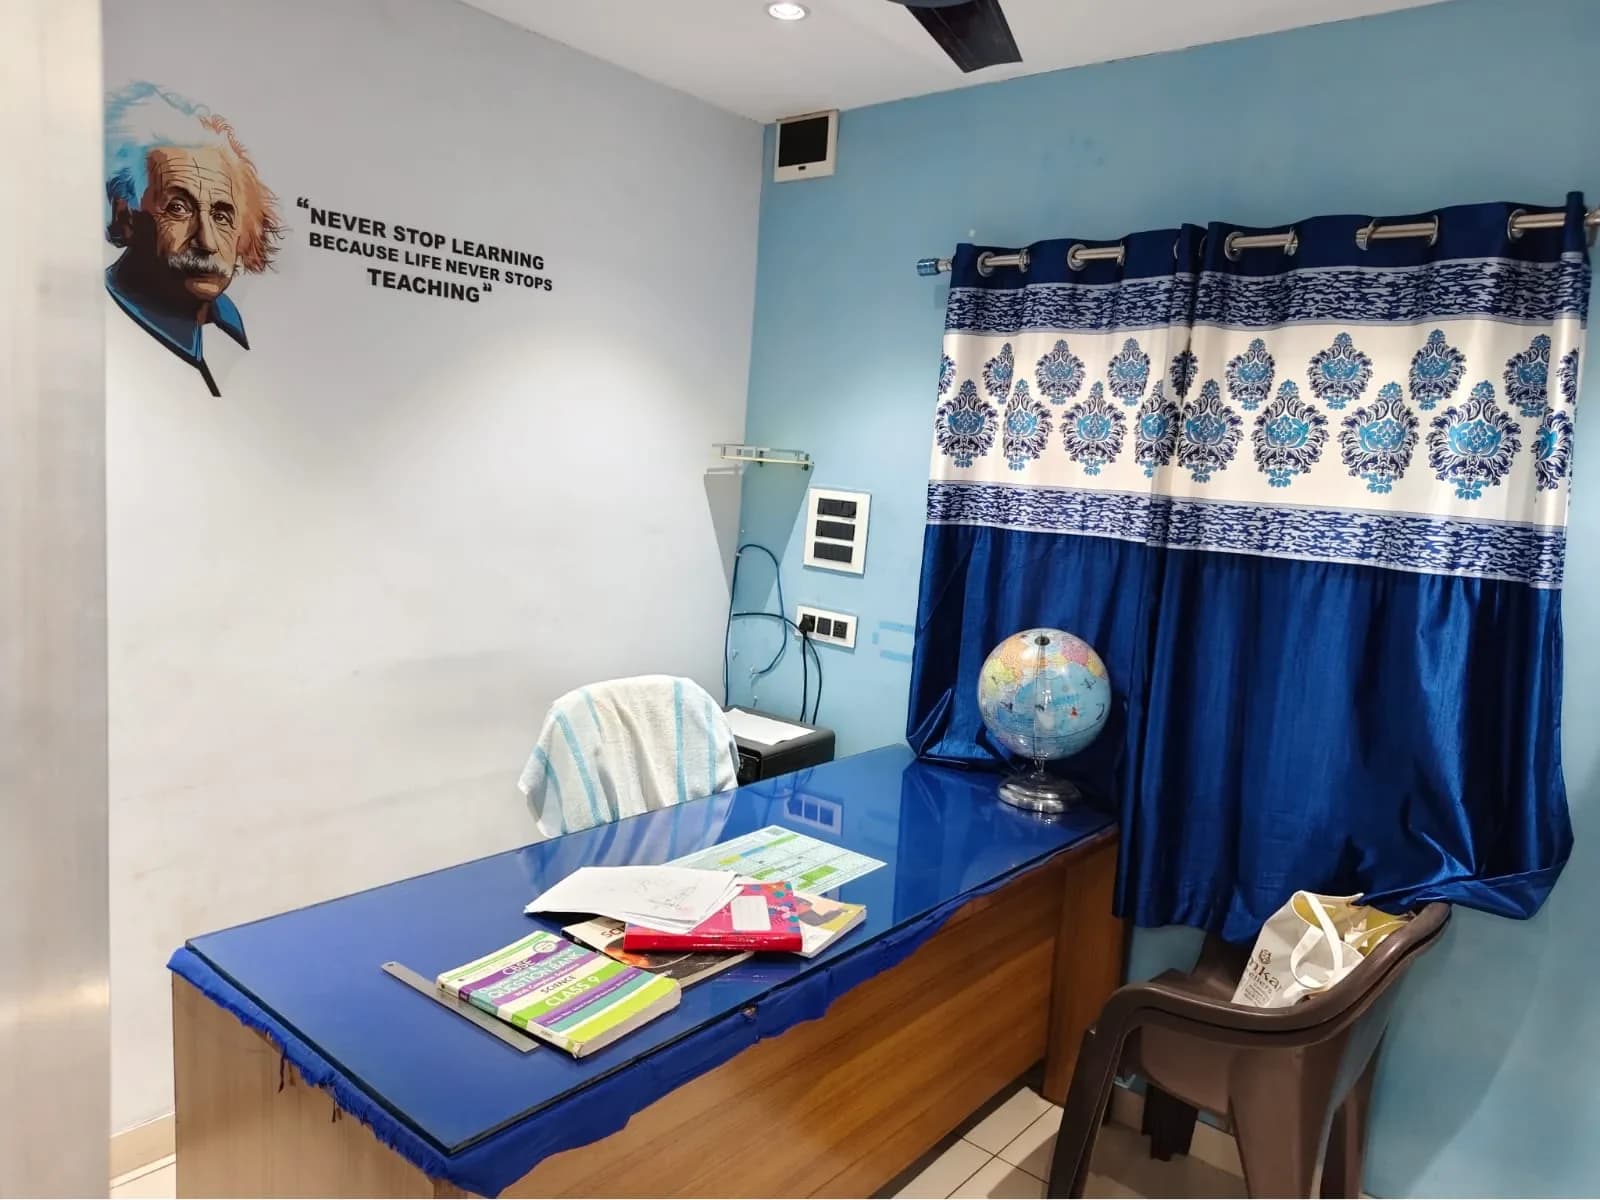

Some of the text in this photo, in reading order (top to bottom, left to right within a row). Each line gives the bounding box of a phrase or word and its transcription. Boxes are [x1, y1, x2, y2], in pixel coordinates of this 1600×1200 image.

[309, 232, 553, 292] BECAUSE LIFE NEVER STOPS
[393, 225, 446, 249] STOP
[452, 238, 545, 271] LEARNING
[502, 958, 536, 975] CBSE
[540, 974, 577, 994] SCIENCE
[544, 975, 601, 1007] CLASS 9
